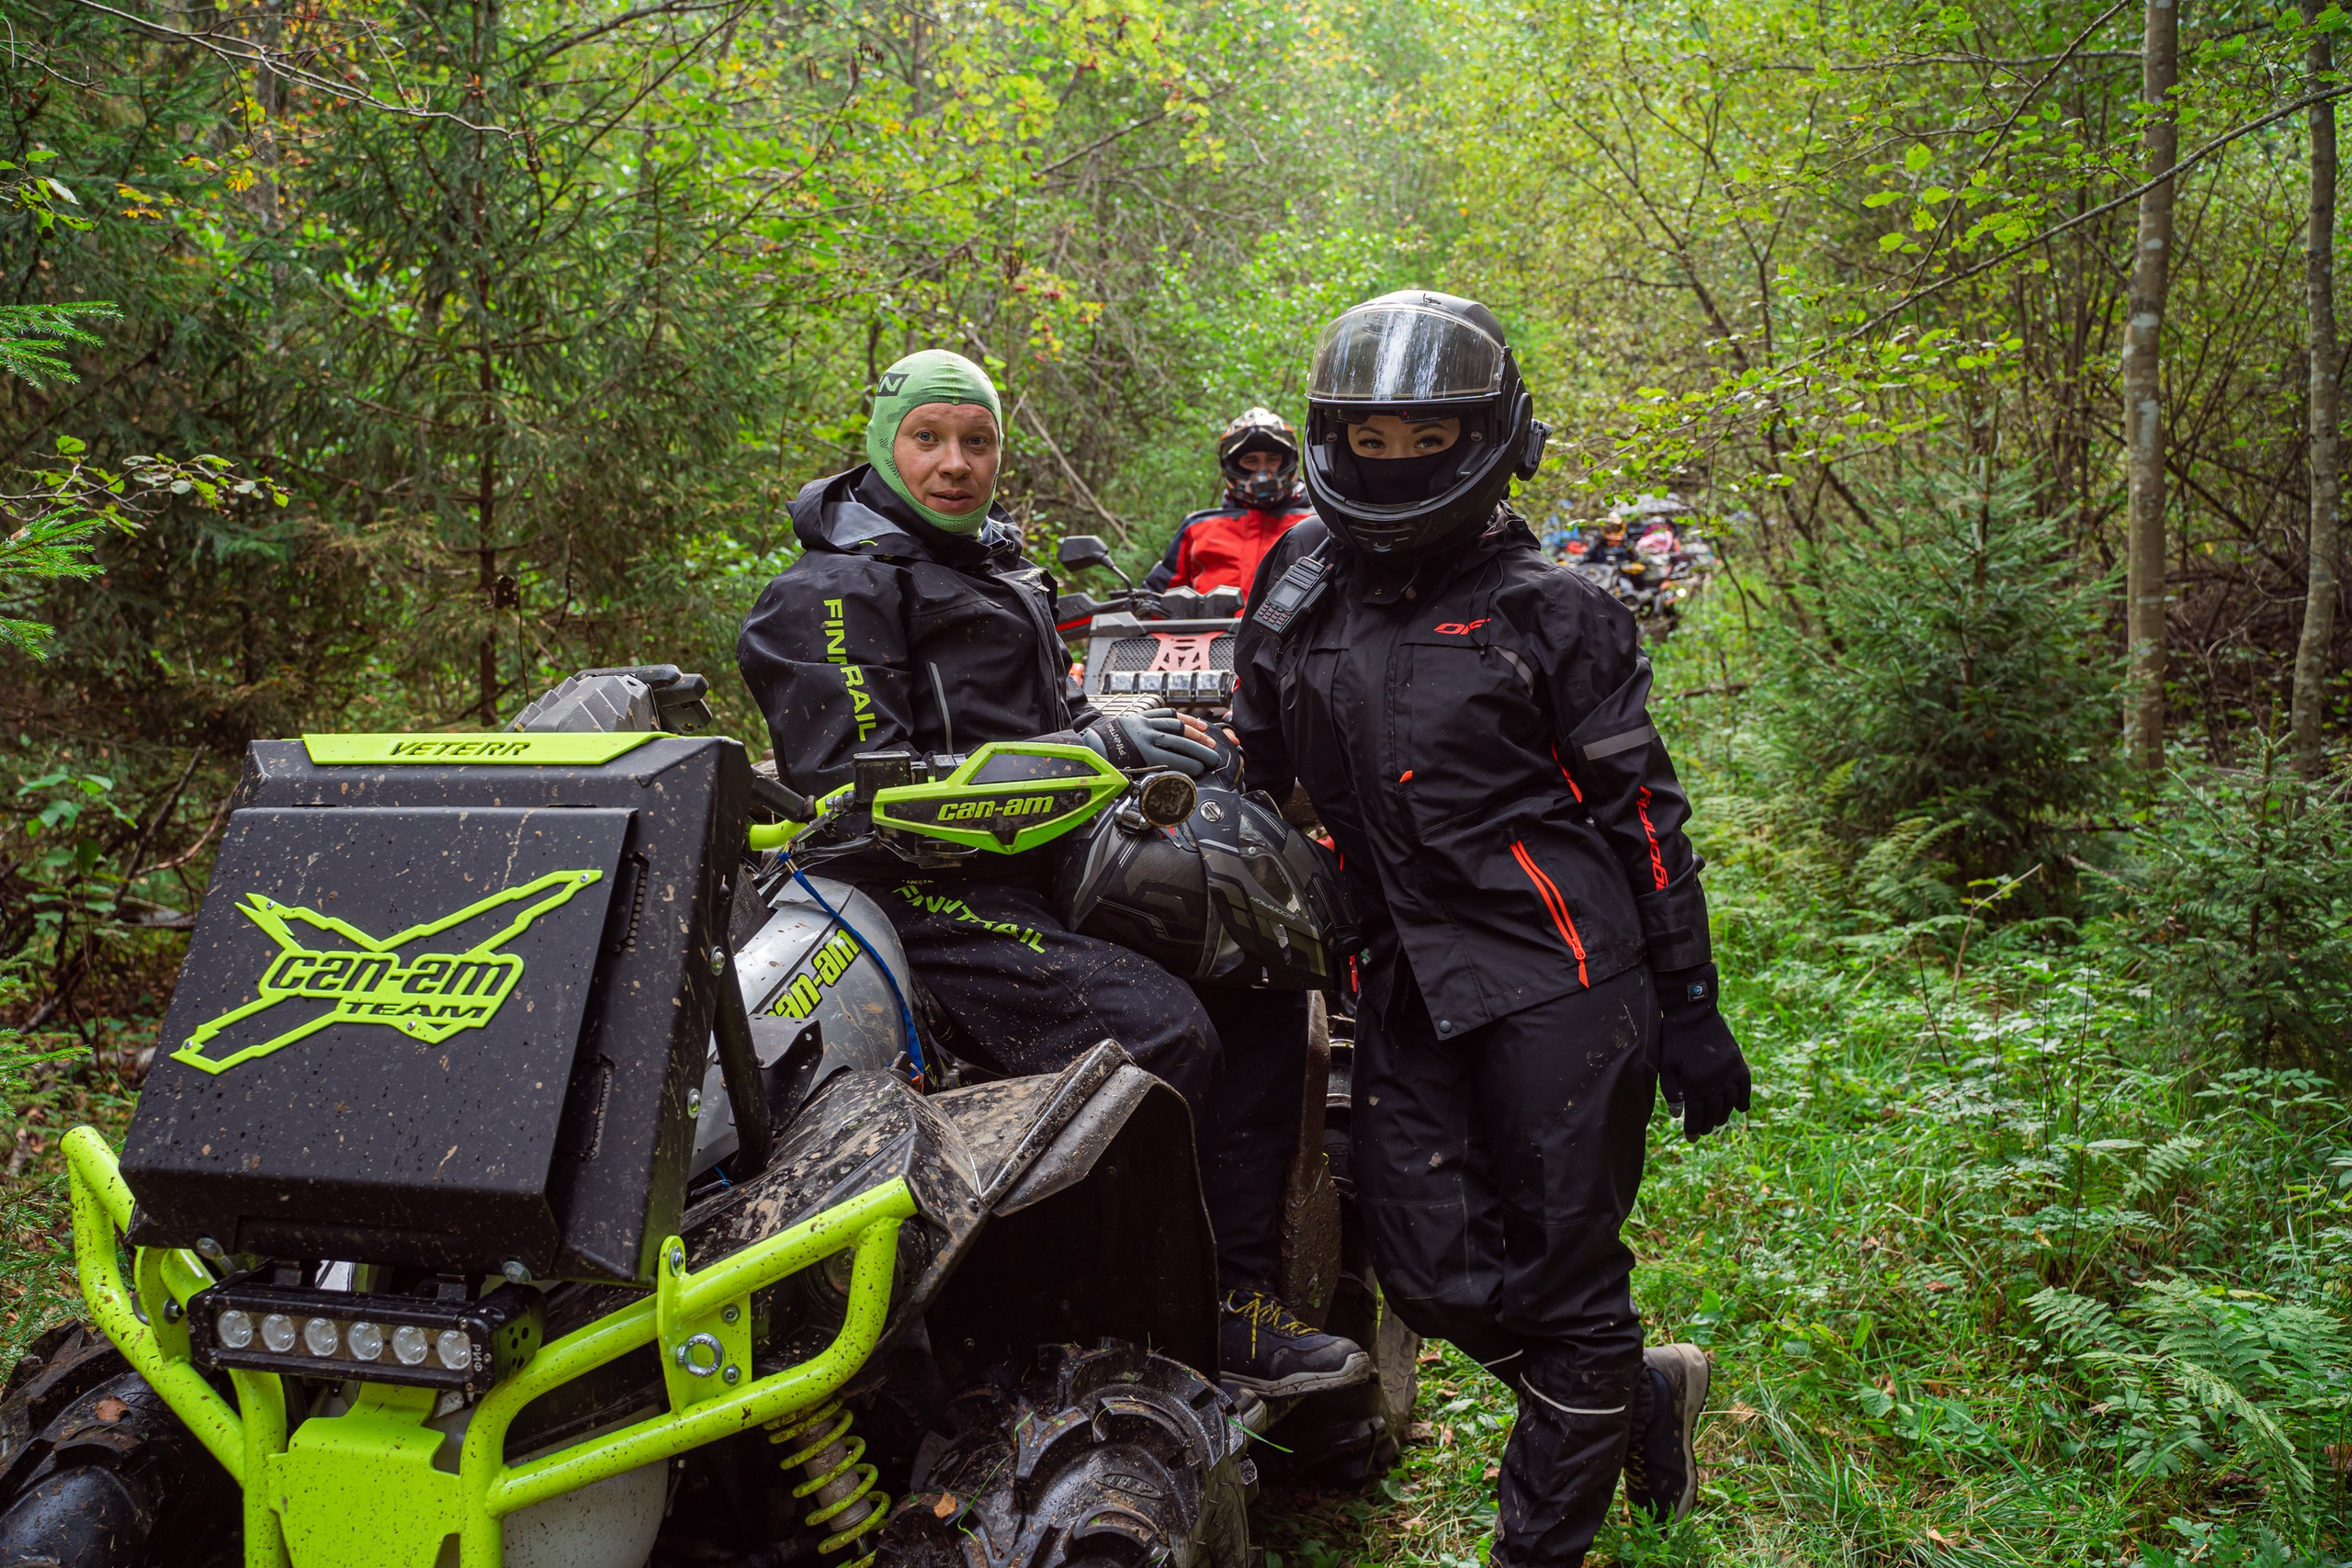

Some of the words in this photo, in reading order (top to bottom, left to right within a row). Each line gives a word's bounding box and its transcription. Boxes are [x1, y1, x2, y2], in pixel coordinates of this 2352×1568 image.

[823, 598, 876, 742] FINRAIL
[389, 741, 532, 756] VETERR
[937, 795, 1055, 821] can-am
[267, 956, 514, 997] can-am
[764, 928, 861, 1020] an-am
[344, 1001, 489, 1019] TEAM
